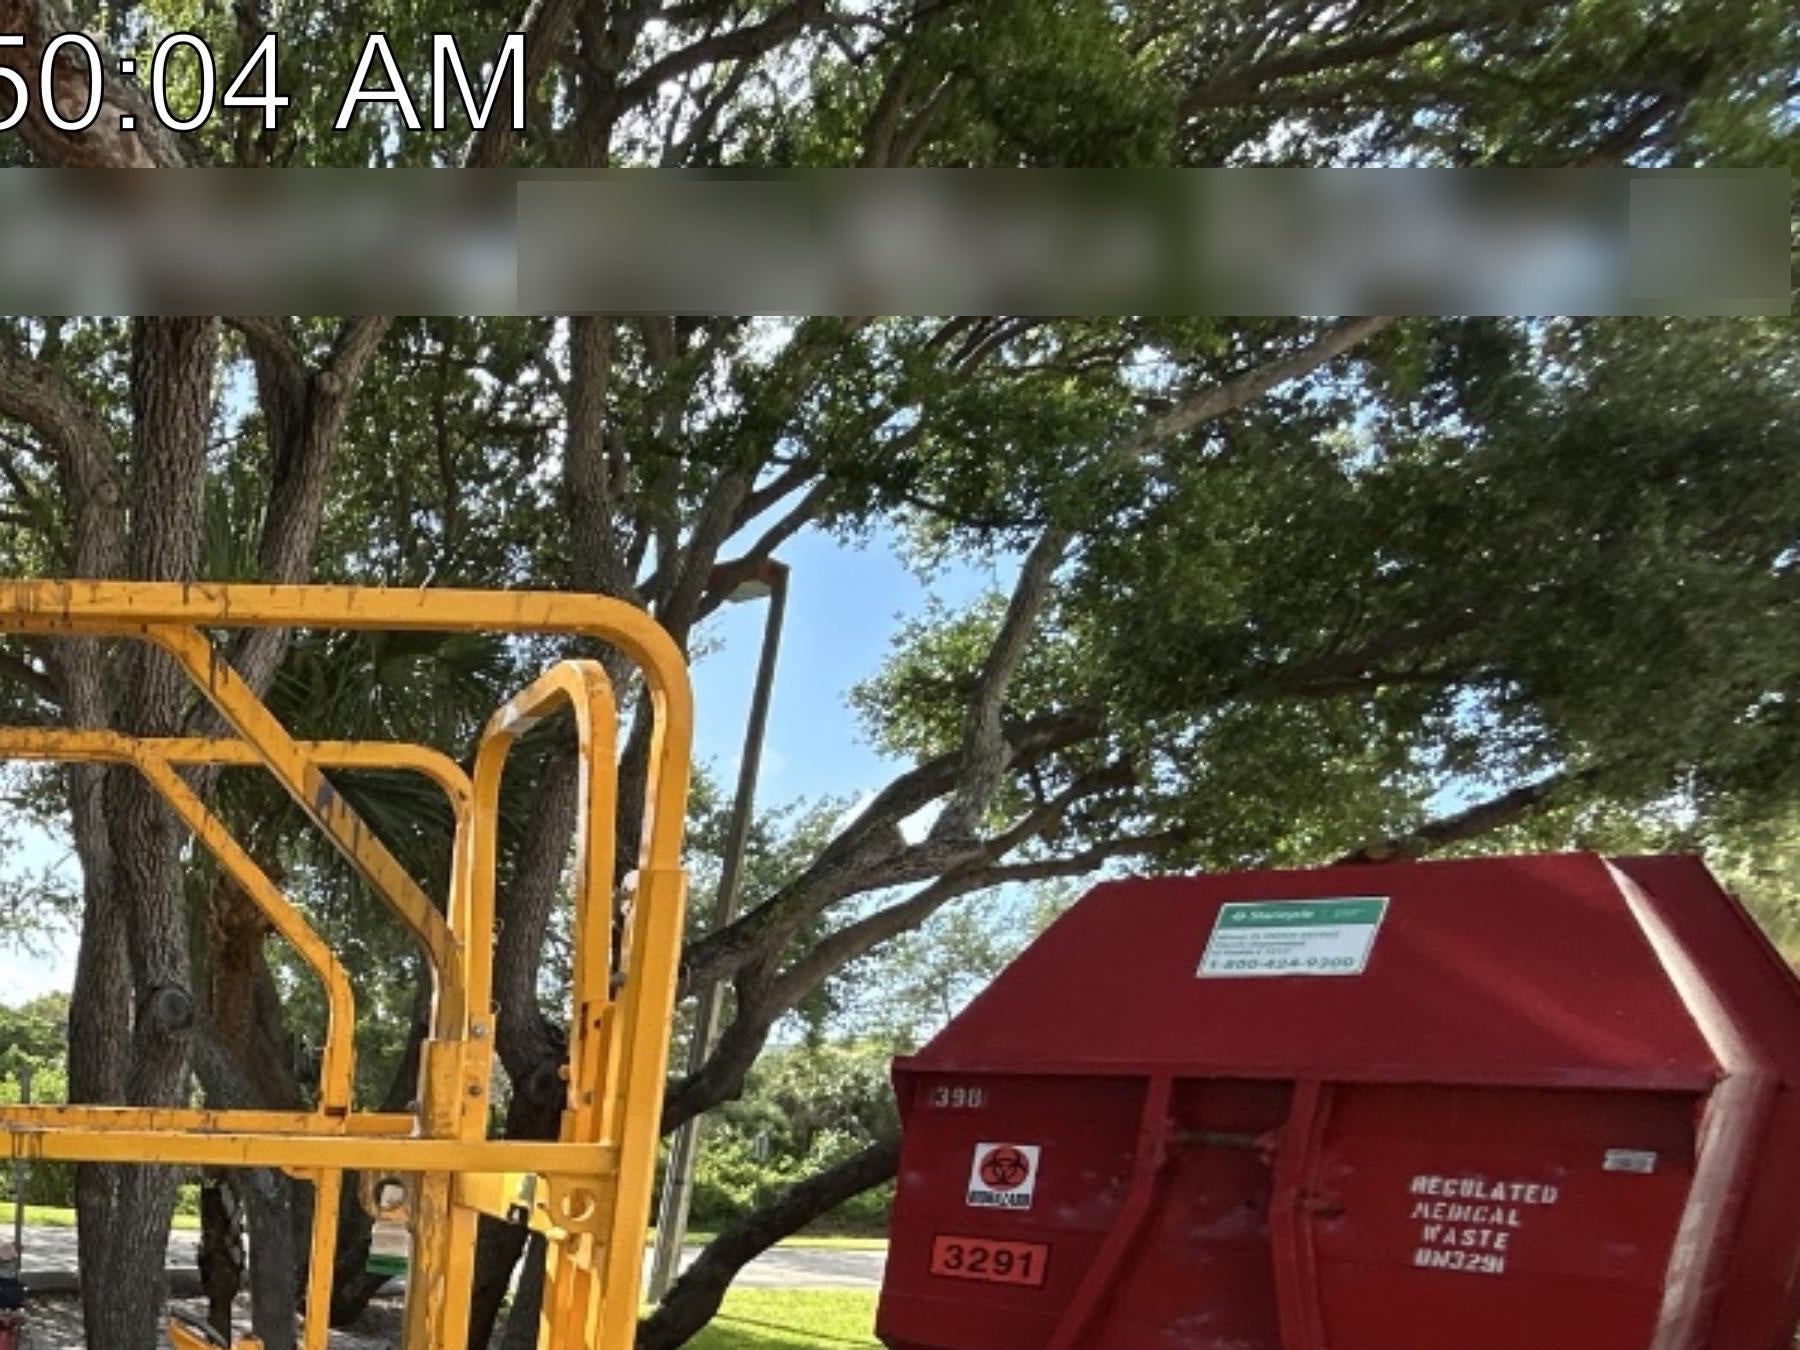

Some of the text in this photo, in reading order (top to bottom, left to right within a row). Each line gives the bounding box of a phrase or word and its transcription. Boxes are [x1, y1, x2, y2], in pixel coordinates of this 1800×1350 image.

[1410, 1175, 1559, 1205] REGULATED
[1409, 1201, 1522, 1227] MEDICAL
[1423, 1222, 1510, 1250] WASTE
[943, 1244, 1033, 1278] 3291
